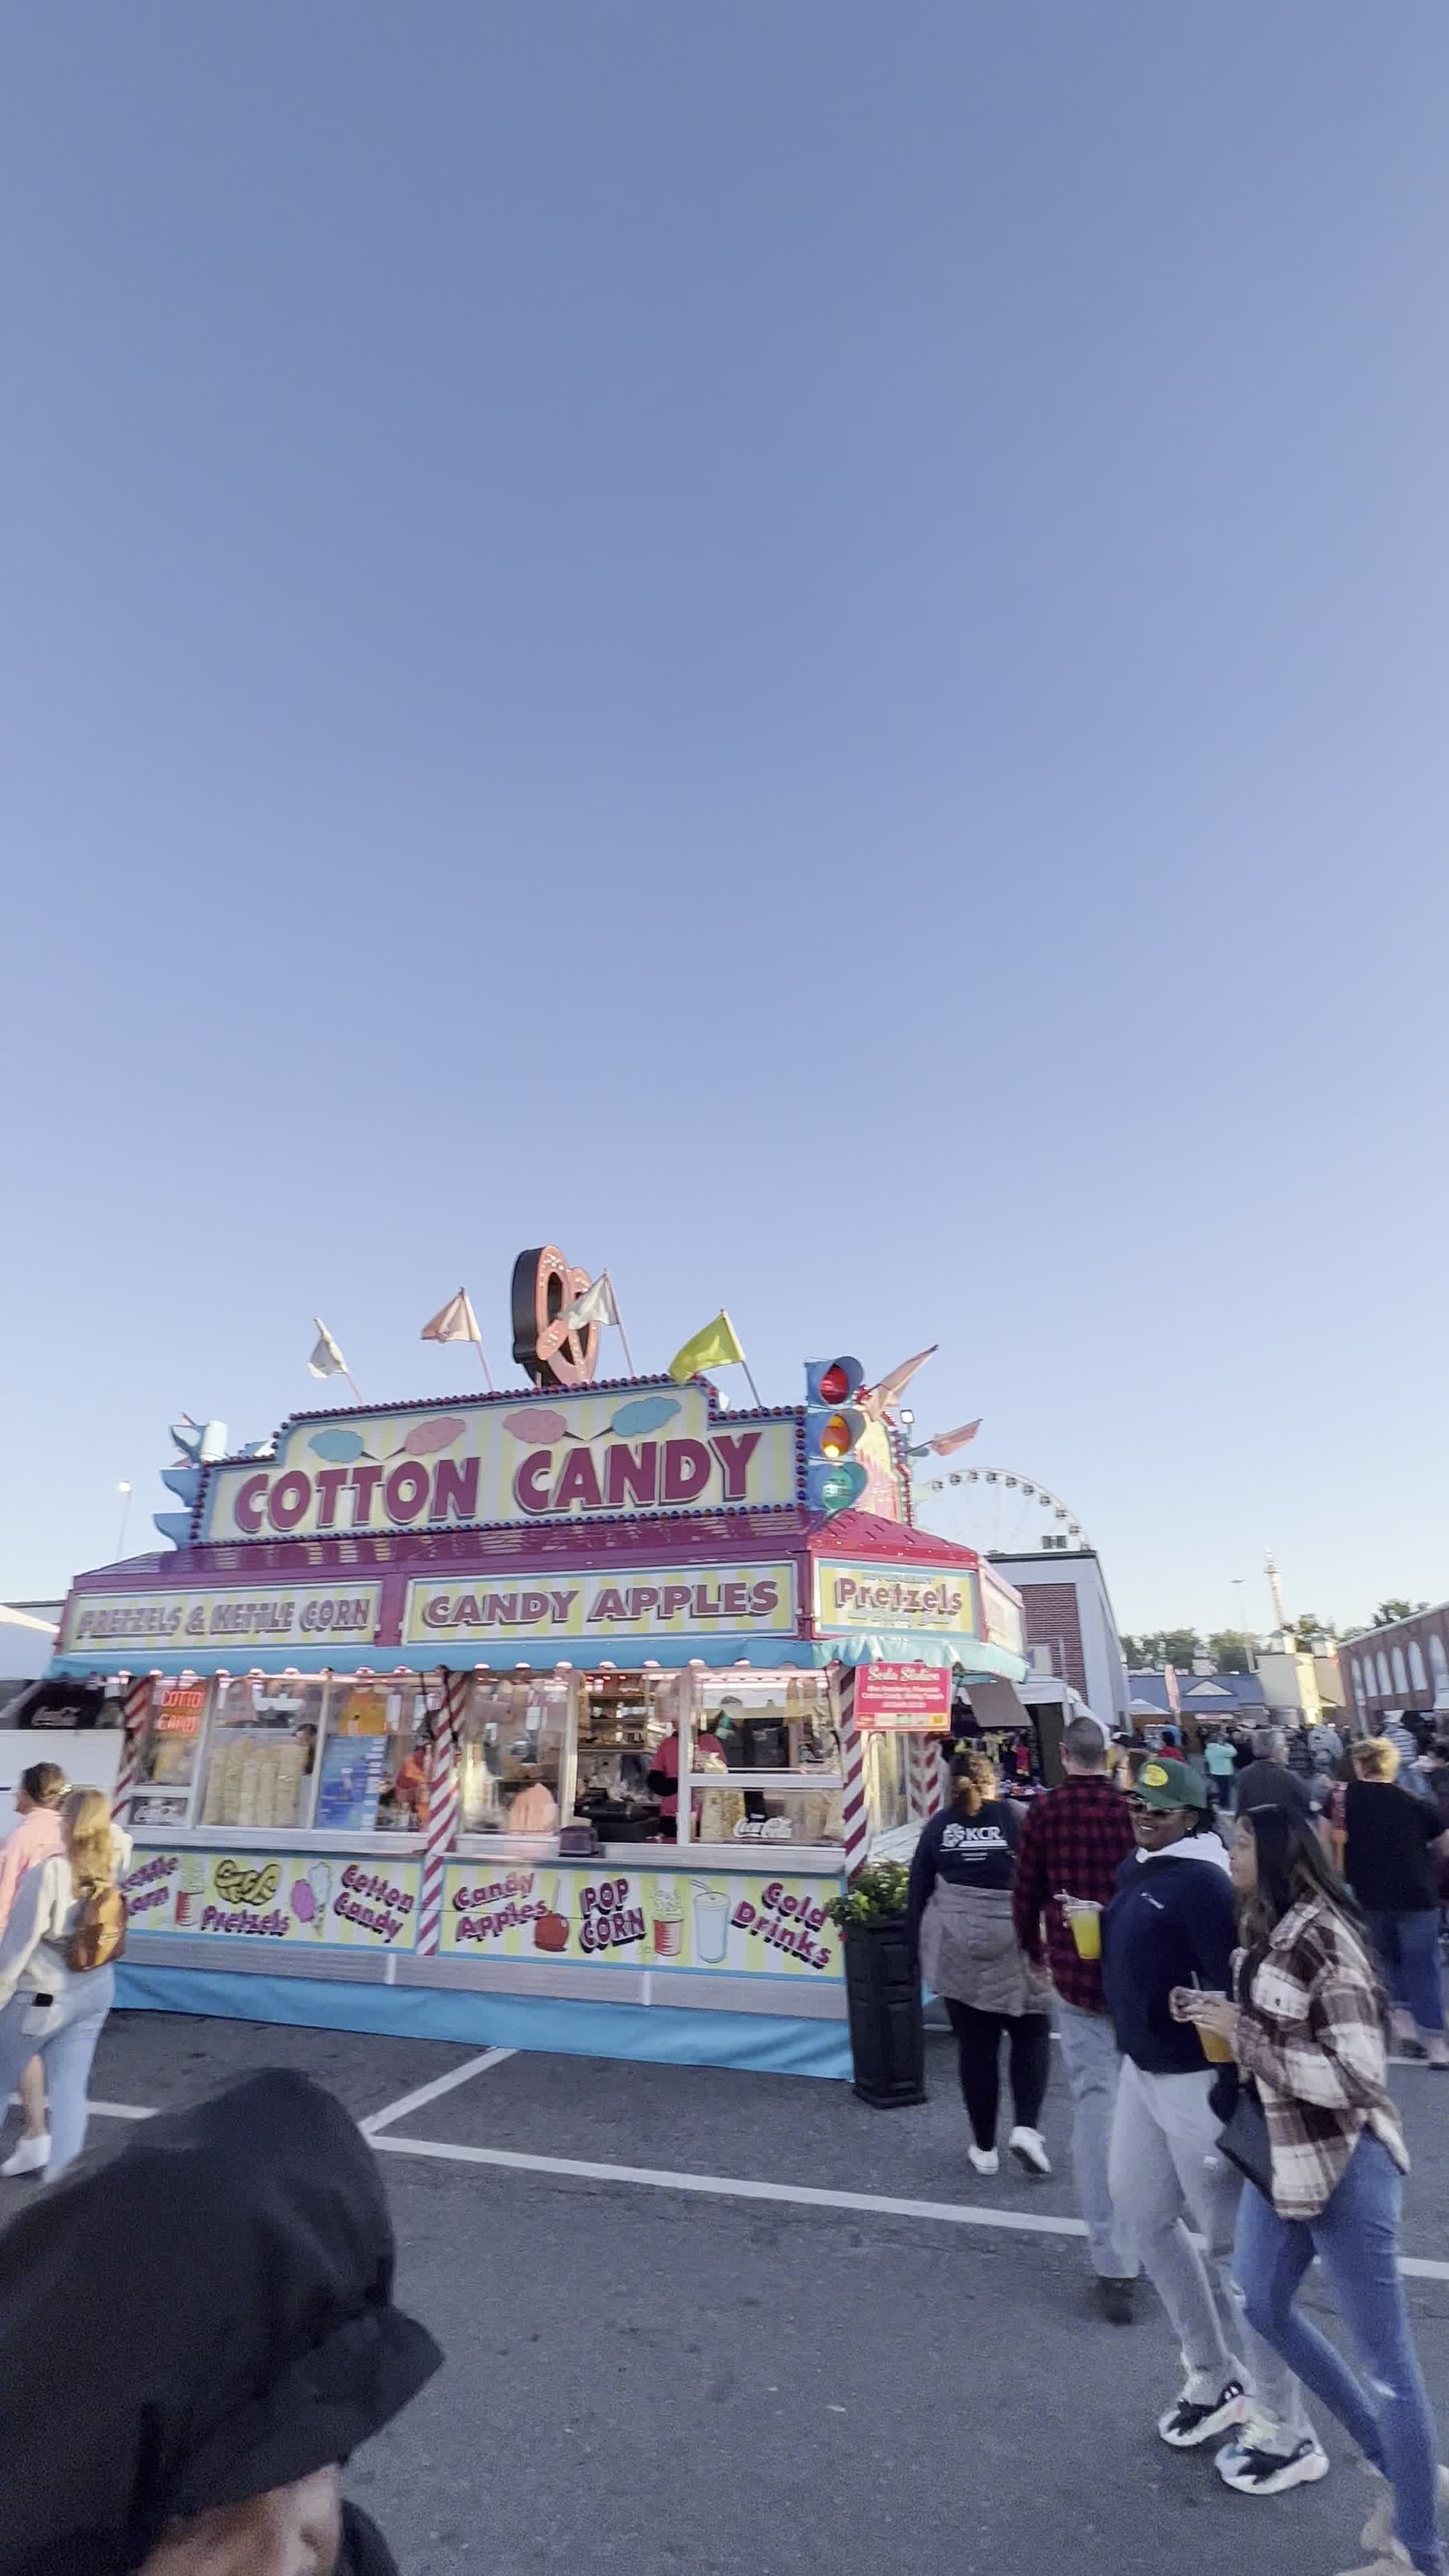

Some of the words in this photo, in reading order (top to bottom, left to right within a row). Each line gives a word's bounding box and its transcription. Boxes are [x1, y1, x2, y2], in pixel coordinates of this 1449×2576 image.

[235, 1464, 481, 1532] COTTON
[515, 1432, 763, 1515] CANDY
[210, 1602, 296, 1634] KETTLE
[301, 1599, 370, 1631] CORN
[422, 1590, 579, 1627] CANDY
[587, 1581, 779, 1622] APPLES
[836, 1578, 963, 1613] Pretzels
[966, 1827, 1002, 1840] KCR
[342, 1864, 414, 1913] Cotton
[453, 1872, 535, 1911] Candy
[580, 1878, 629, 1919] POP
[762, 1882, 828, 1932] Cold
[201, 1905, 290, 1936] Pretzels
[334, 1892, 404, 1943] Candy
[456, 1900, 547, 1941] Apples
[580, 1907, 647, 1953] CORN
[731, 1900, 832, 1969] Drinks
